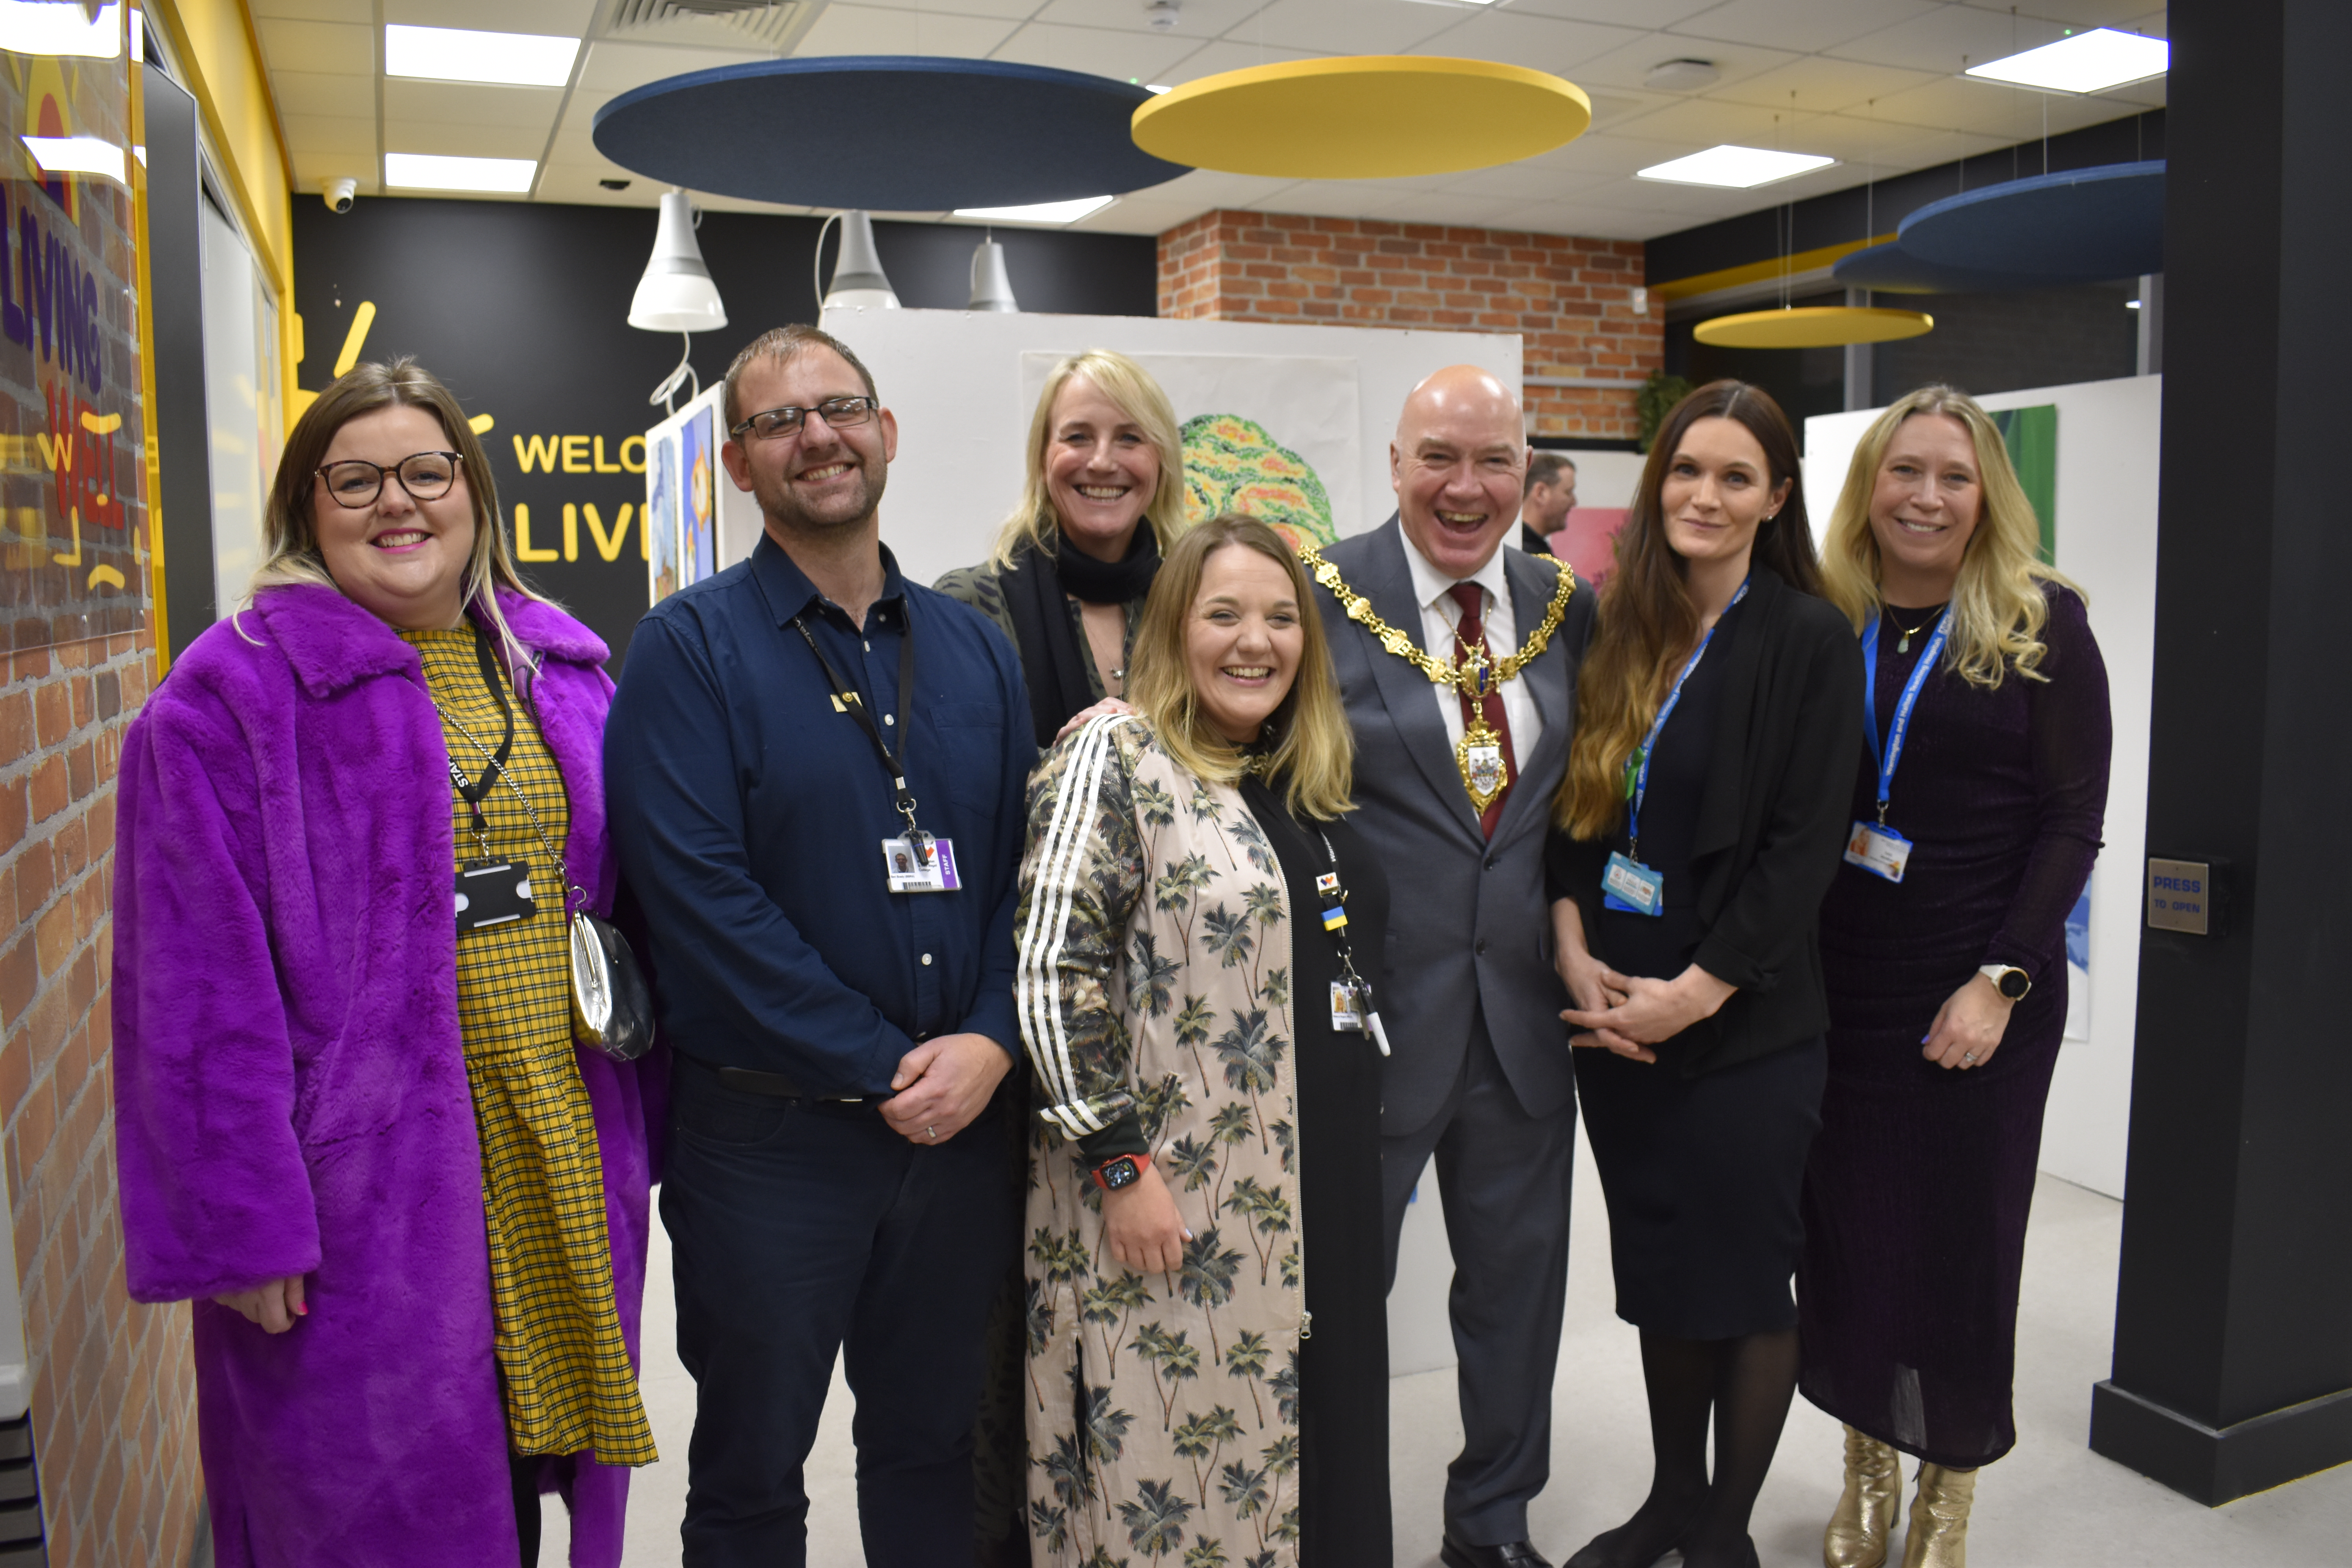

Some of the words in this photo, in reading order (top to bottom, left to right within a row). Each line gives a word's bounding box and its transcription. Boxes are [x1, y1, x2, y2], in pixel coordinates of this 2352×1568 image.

[942, 854, 951, 875] STAFF
[2154, 876, 2200, 893] PRESS
[2155, 899, 2167, 909] TO
[2172, 901, 2200, 913] OPEN
